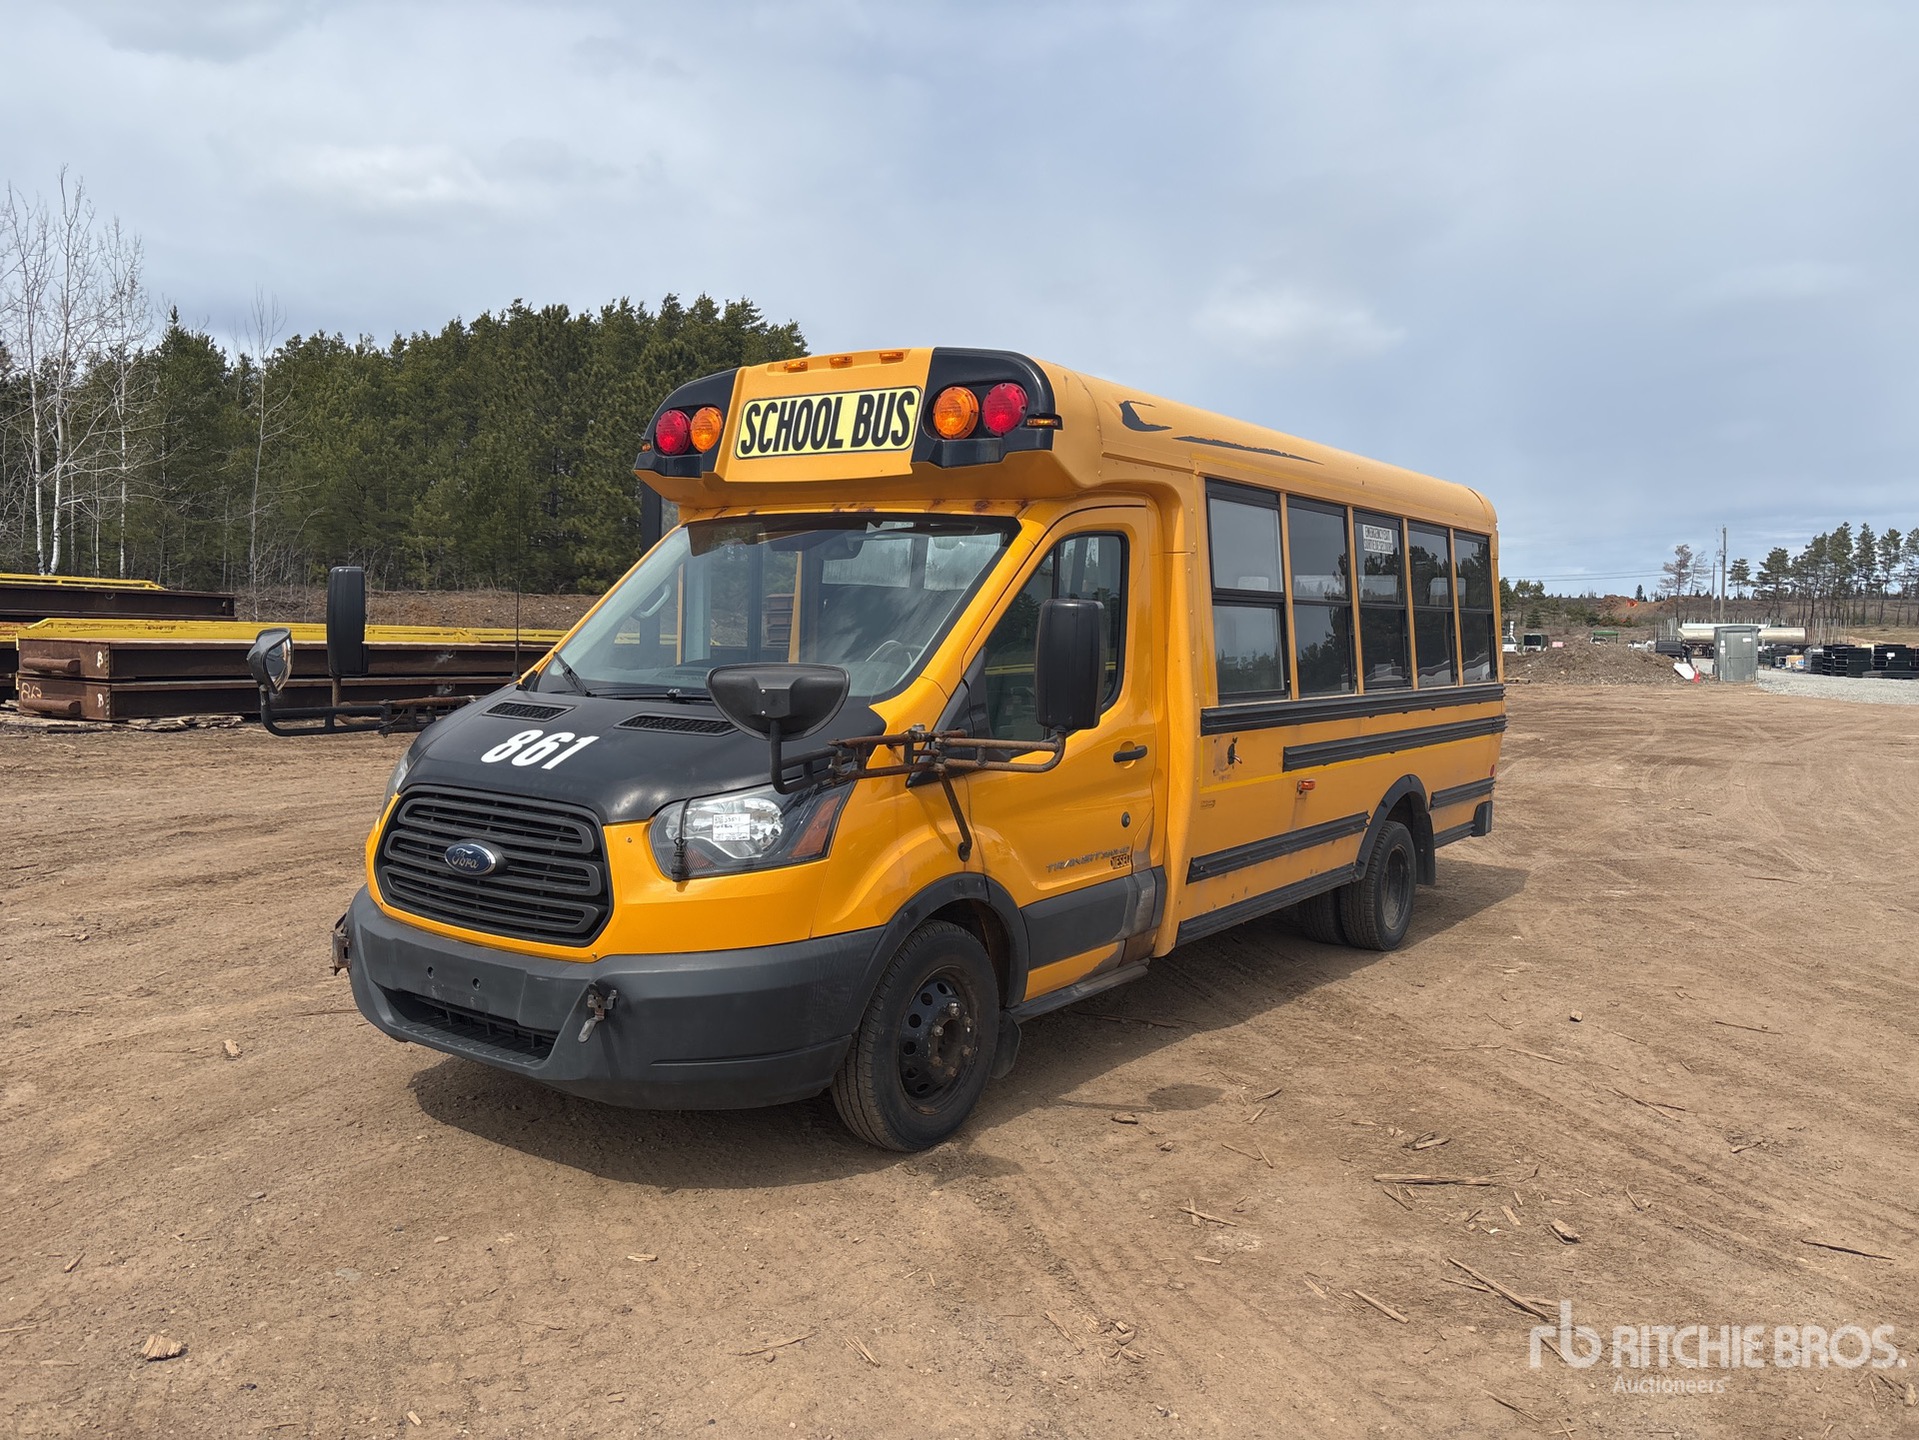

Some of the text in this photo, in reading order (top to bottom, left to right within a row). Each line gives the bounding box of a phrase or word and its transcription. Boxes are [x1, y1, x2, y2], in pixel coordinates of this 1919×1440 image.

[740, 391, 915, 455] SCHOOL BUS
[481, 729, 600, 770] 861
[451, 847, 480, 870] Ford
